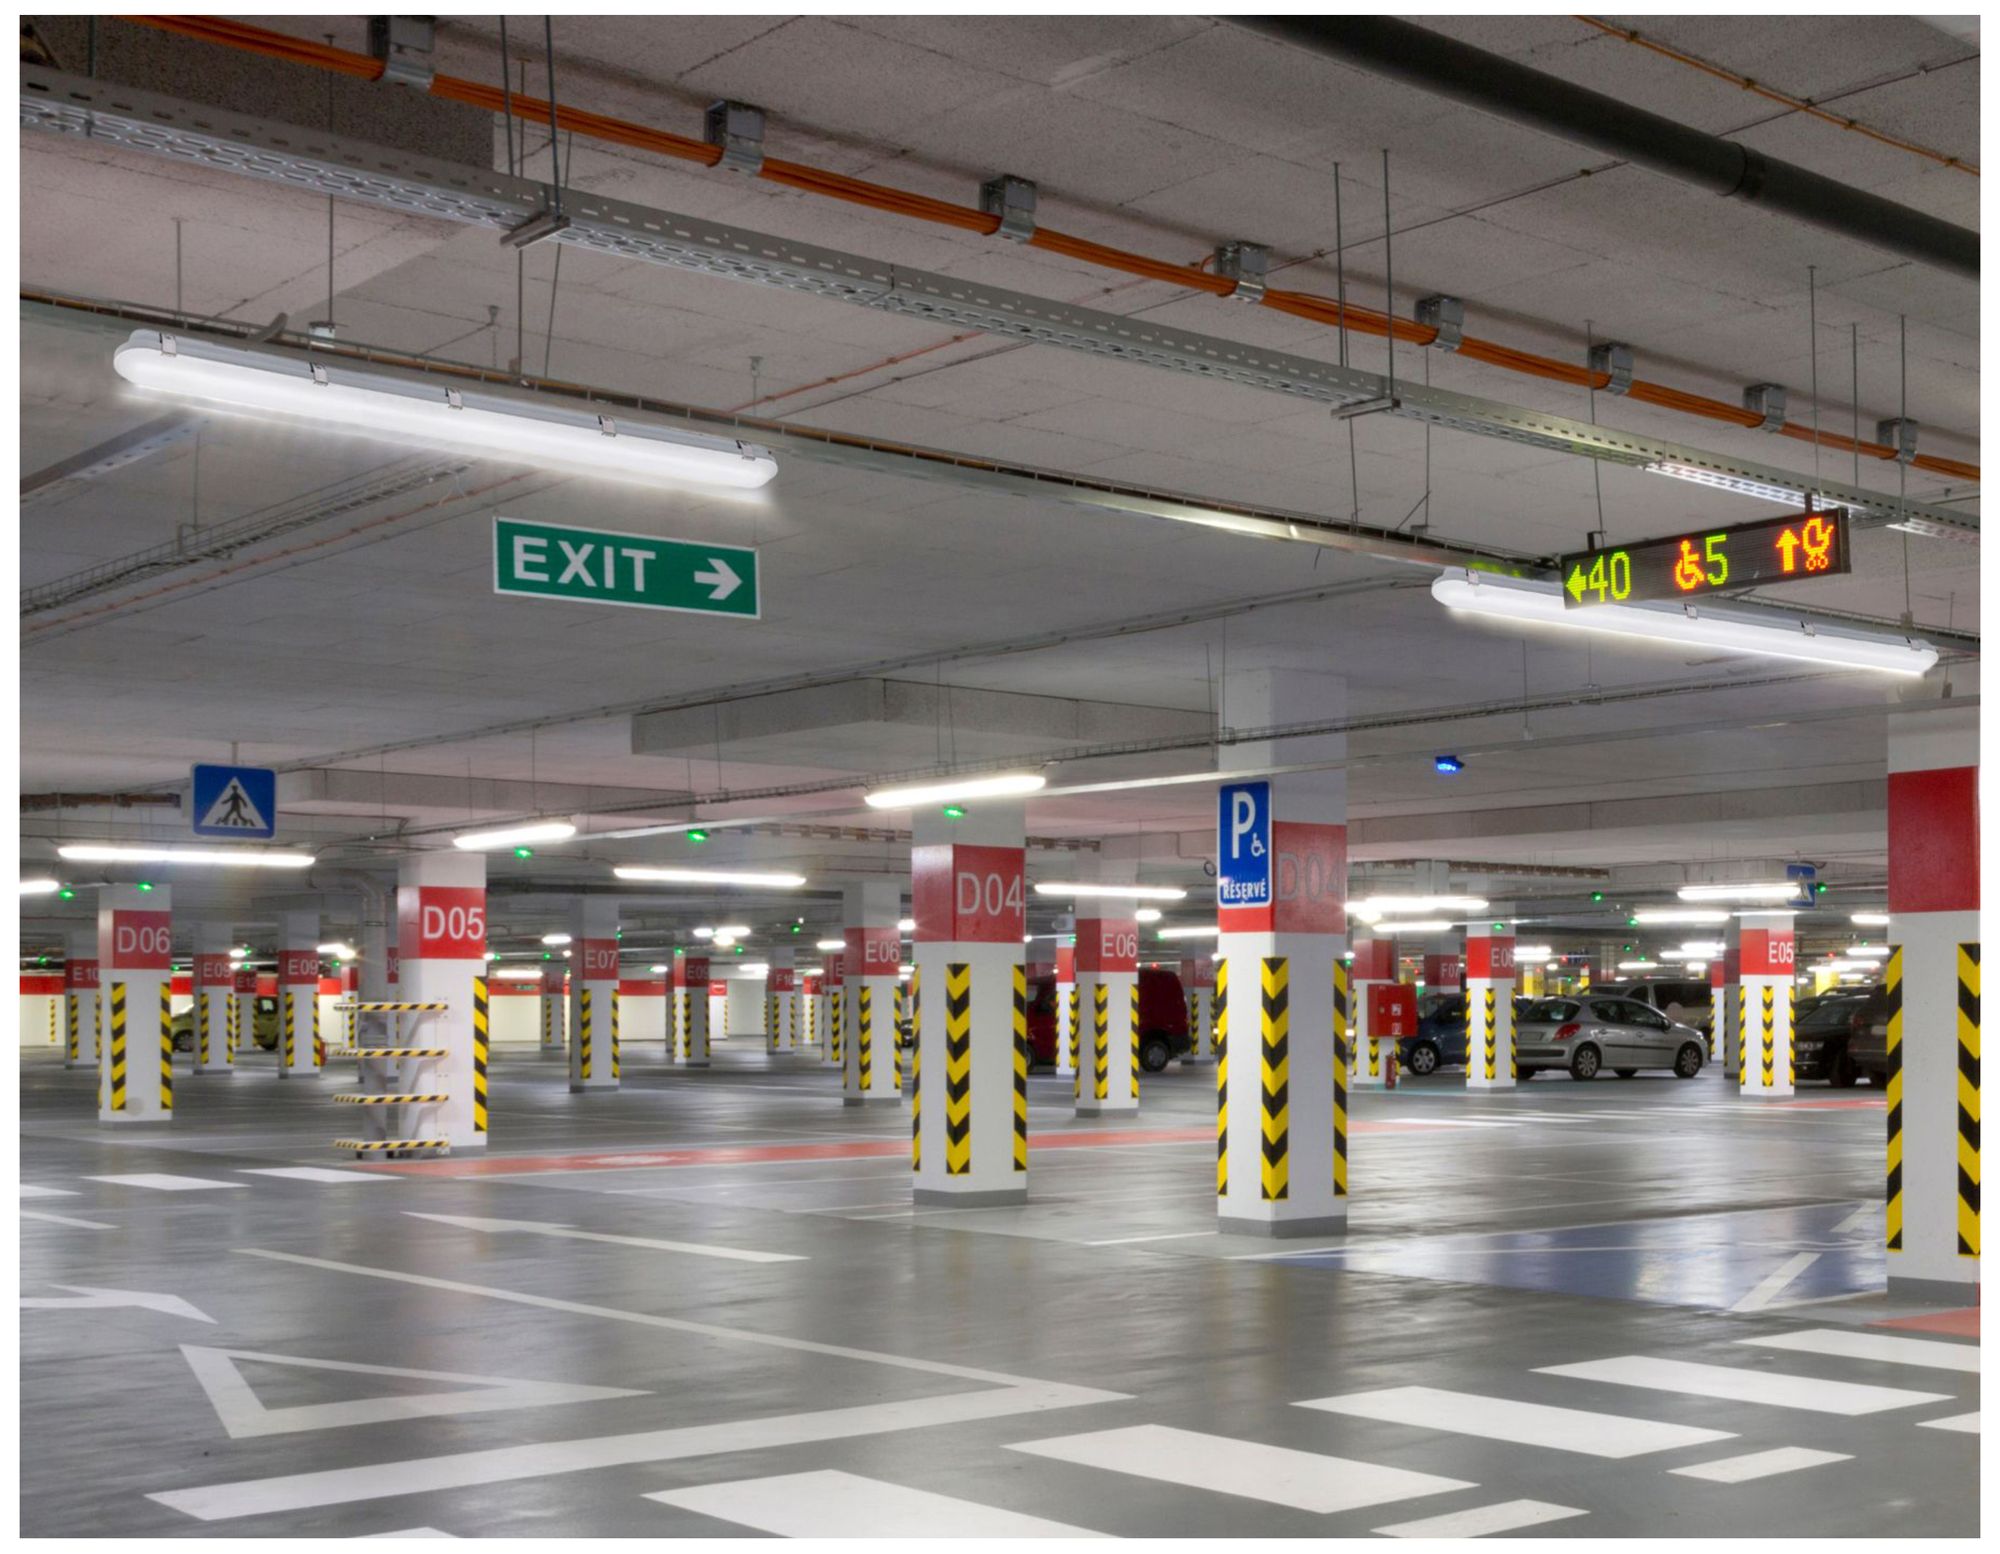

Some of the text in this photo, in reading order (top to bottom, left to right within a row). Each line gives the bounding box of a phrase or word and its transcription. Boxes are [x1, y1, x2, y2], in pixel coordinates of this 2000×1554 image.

[513, 535, 656, 592] EXIT
[1589, 534, 1728, 602] 40 5
[1232, 791, 1256, 859] P
[1278, 851, 1344, 904] D04
[957, 871, 1023, 917] D04
[423, 906, 484, 940] D05
[118, 926, 170, 953] D06
[866, 940, 899, 963] E06
[1102, 934, 1137, 958] E06
[1768, 941, 1794, 963] E05
[288, 959, 318, 975] E09
[584, 950, 617, 969] E07
[1441, 963, 1459, 978] F07
